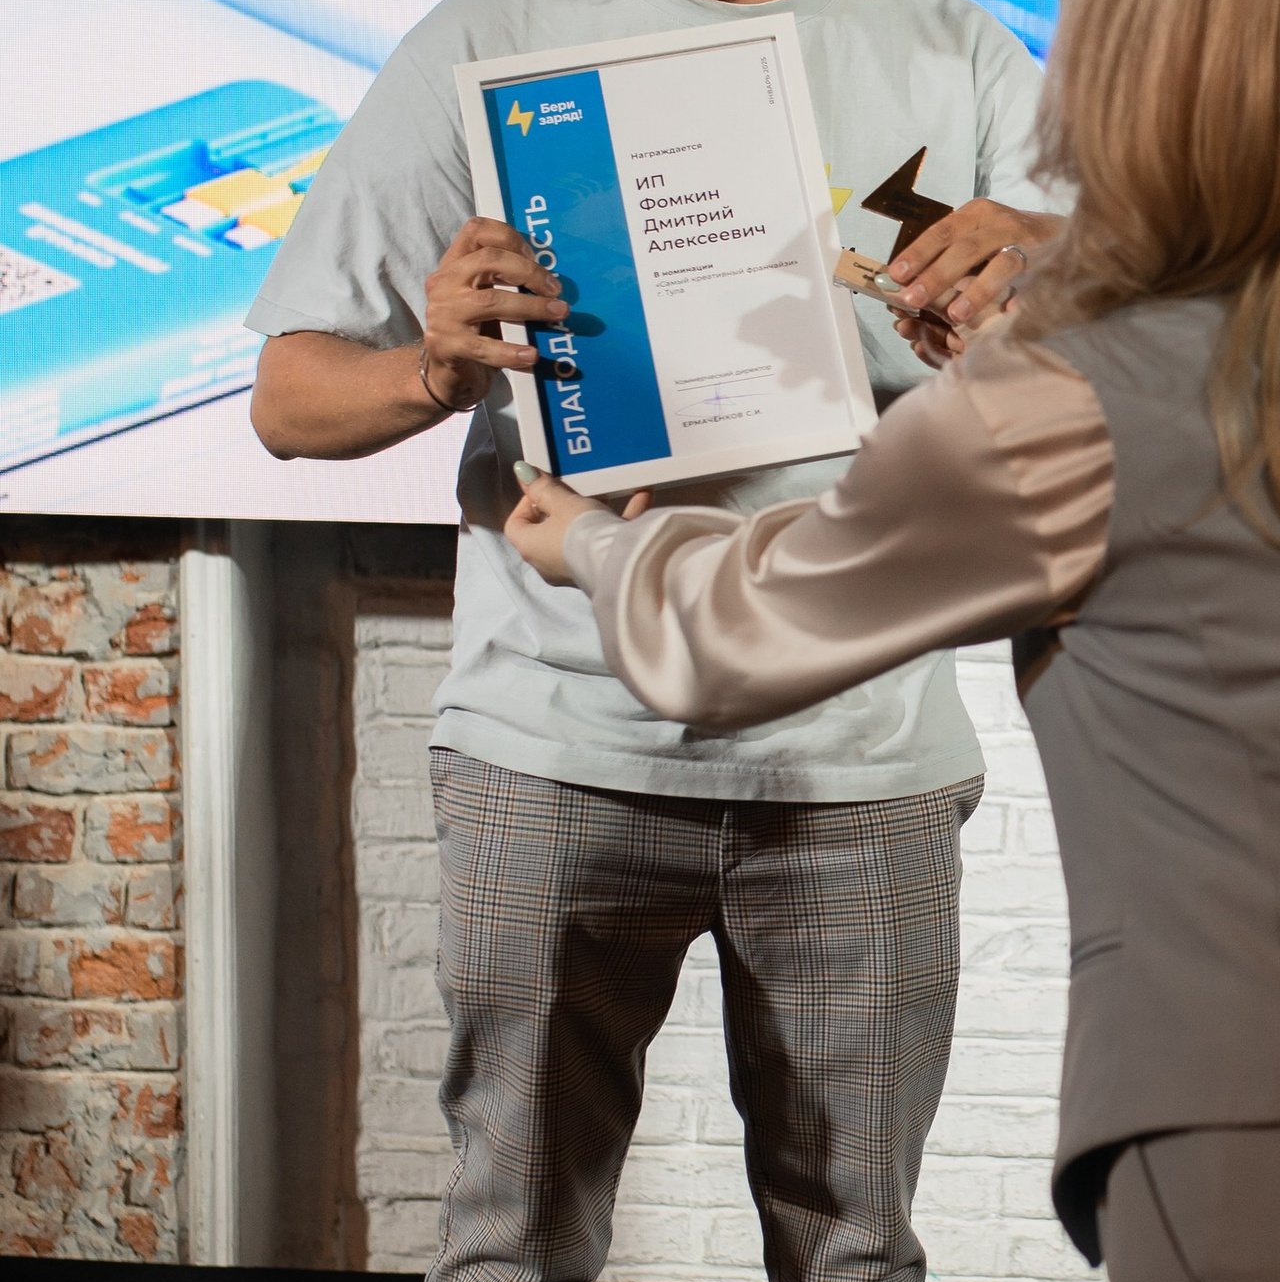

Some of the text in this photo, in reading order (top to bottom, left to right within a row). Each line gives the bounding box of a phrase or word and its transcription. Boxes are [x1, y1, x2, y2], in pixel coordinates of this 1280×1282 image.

[760, 56, 775, 105] ЯНВАРЬ 2025
[540, 100, 576, 114] Бери
[538, 109, 583, 126] заряд!
[631, 143, 703, 160] Награждается
[635, 174, 665, 191] ИП
[639, 189, 720, 211] Фомкин
[644, 205, 734, 235] Дмитрий
[648, 224, 766, 254] Алексеевич
[656, 260, 799, 288] «Самый креативный франчайзи»
[662, 263, 714, 276] номинации
[525, 195, 593, 455] БЛАГОДОСТЬ
[682, 412, 744, 428] ЕРМАЧЕНКОВ
